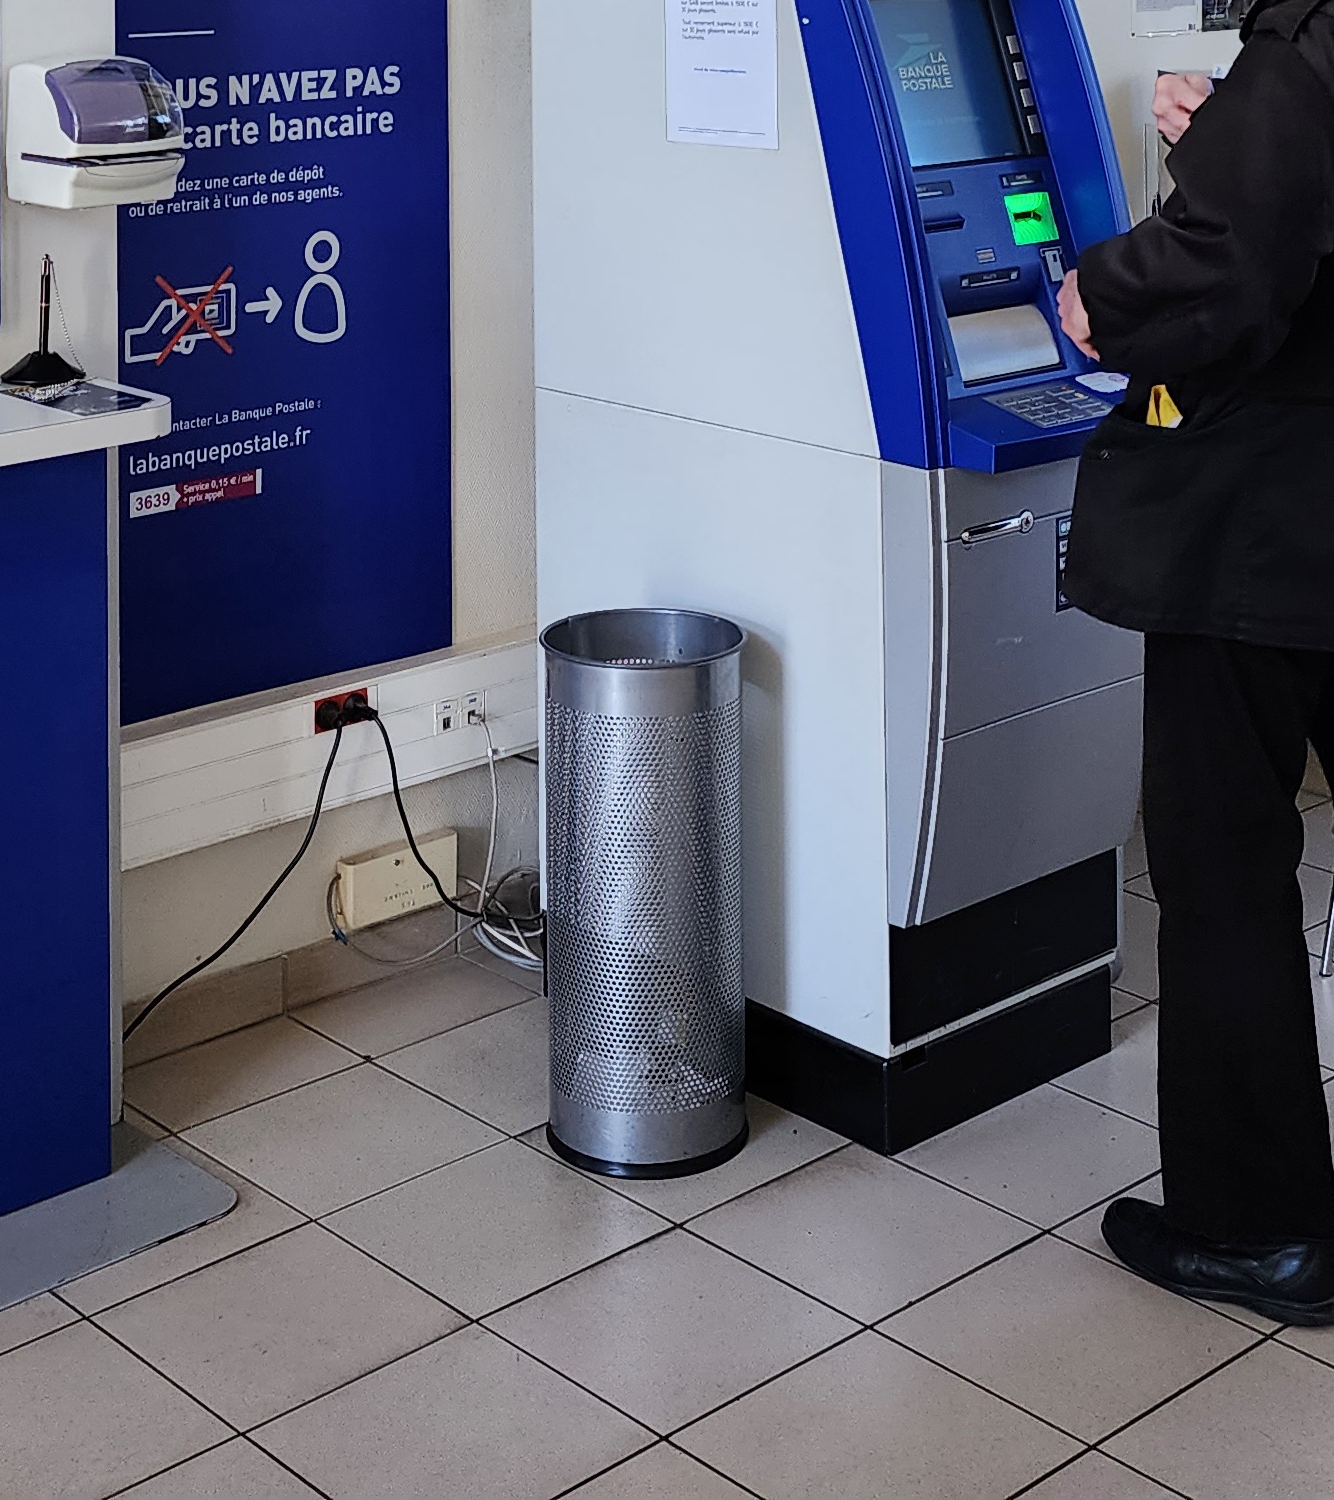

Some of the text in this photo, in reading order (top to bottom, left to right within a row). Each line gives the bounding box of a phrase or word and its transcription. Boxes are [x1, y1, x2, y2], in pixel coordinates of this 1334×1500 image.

[175, 65, 402, 109] US N'AVEZ PAS
[181, 106, 395, 150] carte bancaire
[129, 425, 312, 476] labanquepostale.fr
[135, 491, 171, 512] 3639
